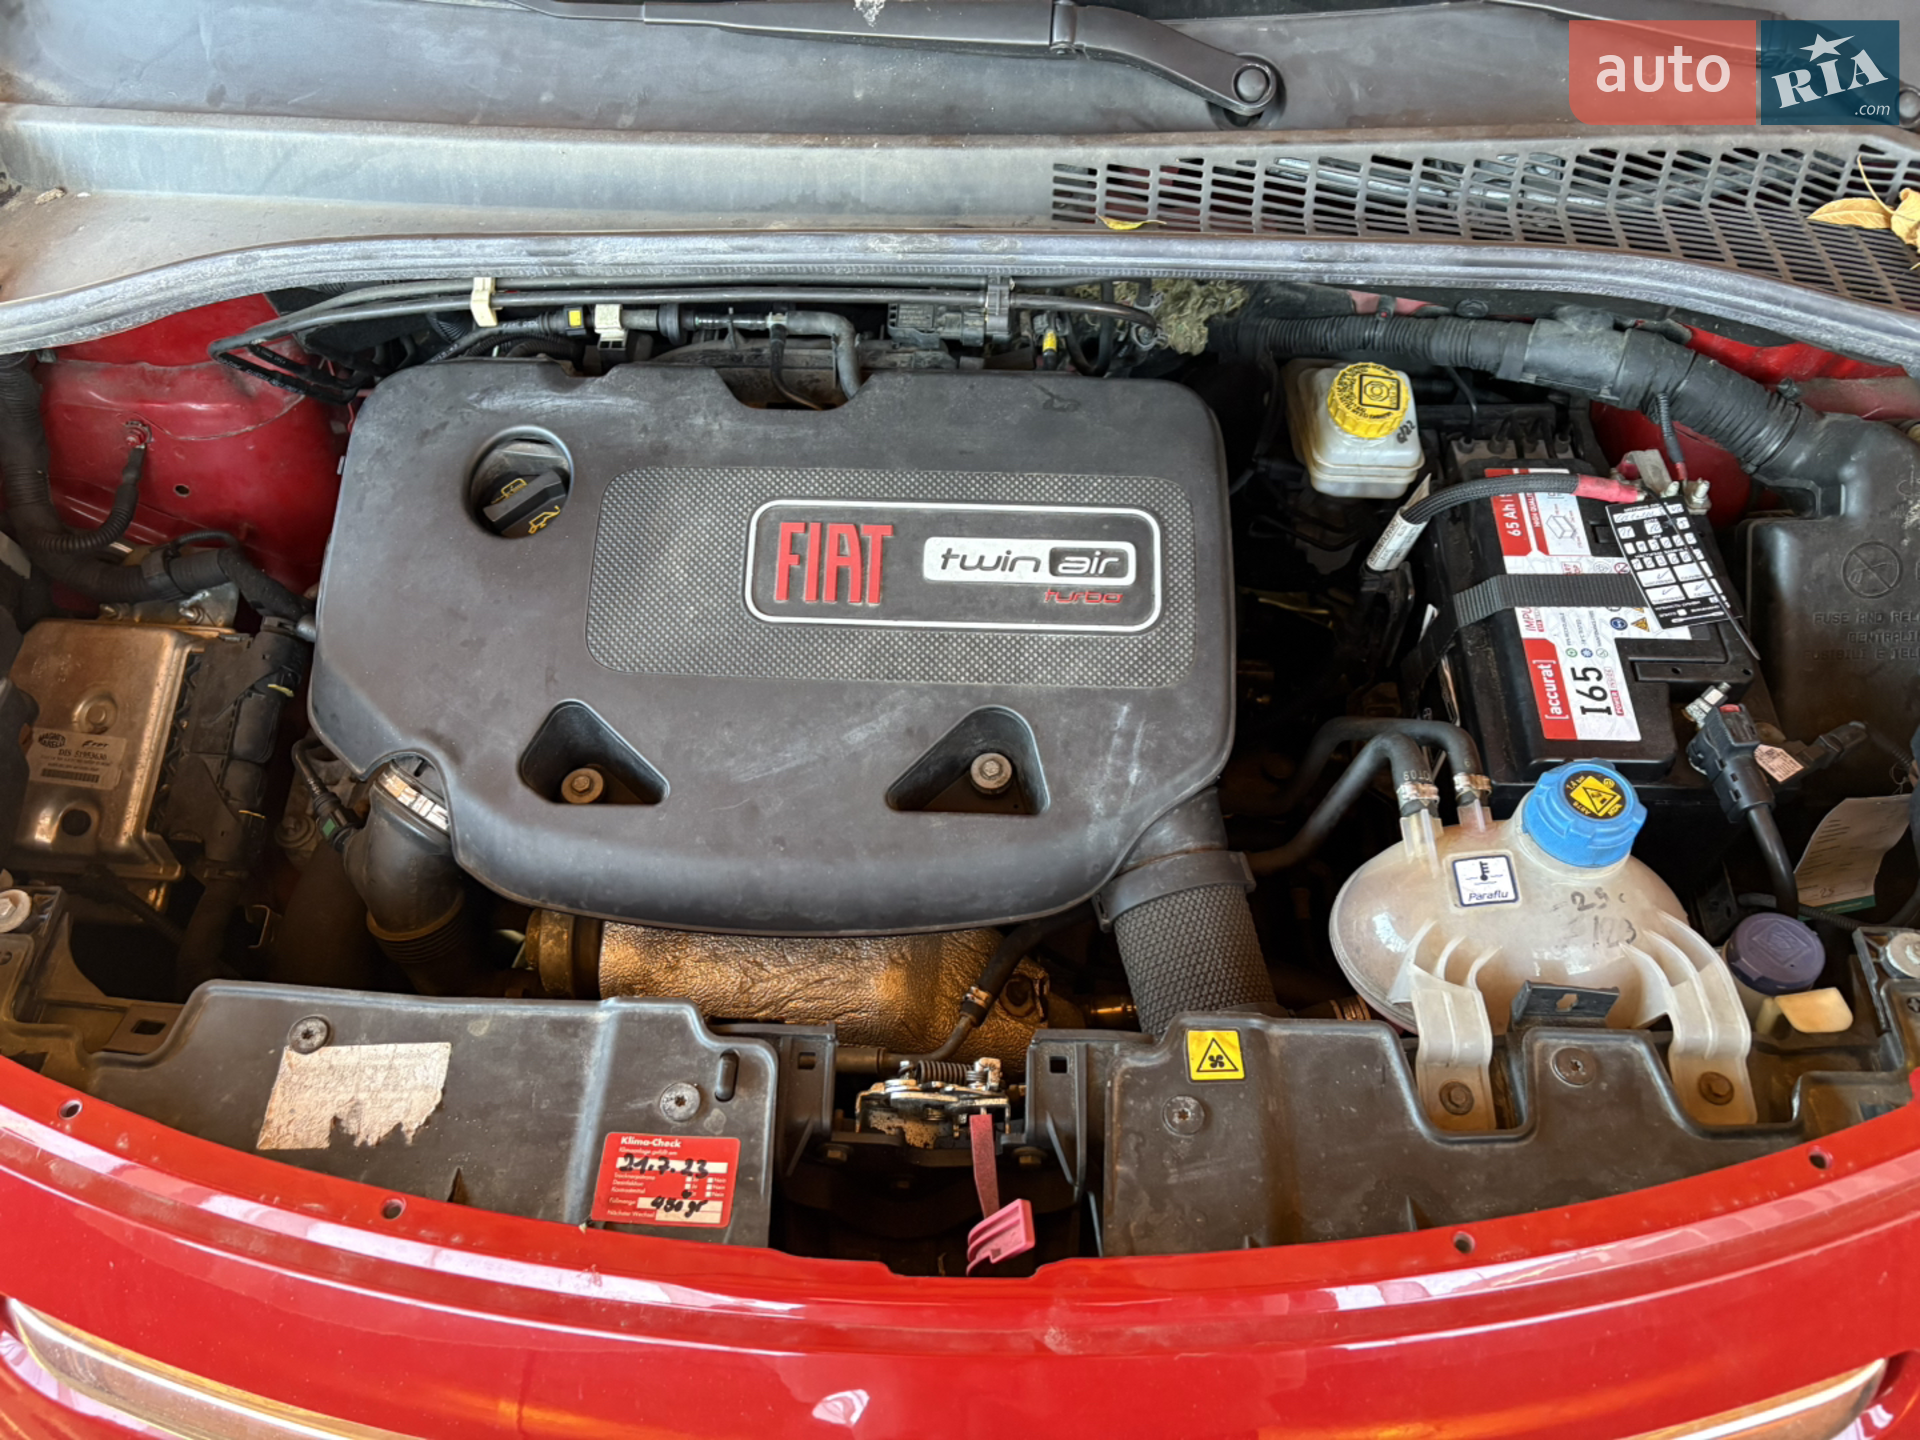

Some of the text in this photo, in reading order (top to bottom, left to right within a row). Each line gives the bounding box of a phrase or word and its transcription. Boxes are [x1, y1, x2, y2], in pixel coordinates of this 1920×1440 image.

[1525, 493, 1539, 512] QUALIT
[1503, 503, 1522, 536] 65 Ah
[775, 522, 893, 604] FIAT
[941, 548, 1120, 576] twin air
[1044, 588, 1124, 604] turbo
[1813, 611, 1850, 624] FUSE
[1856, 611, 1884, 624] AND
[1468, 889, 1509, 902] Paraflu
[620, 1137, 682, 1148] Klima-Check
